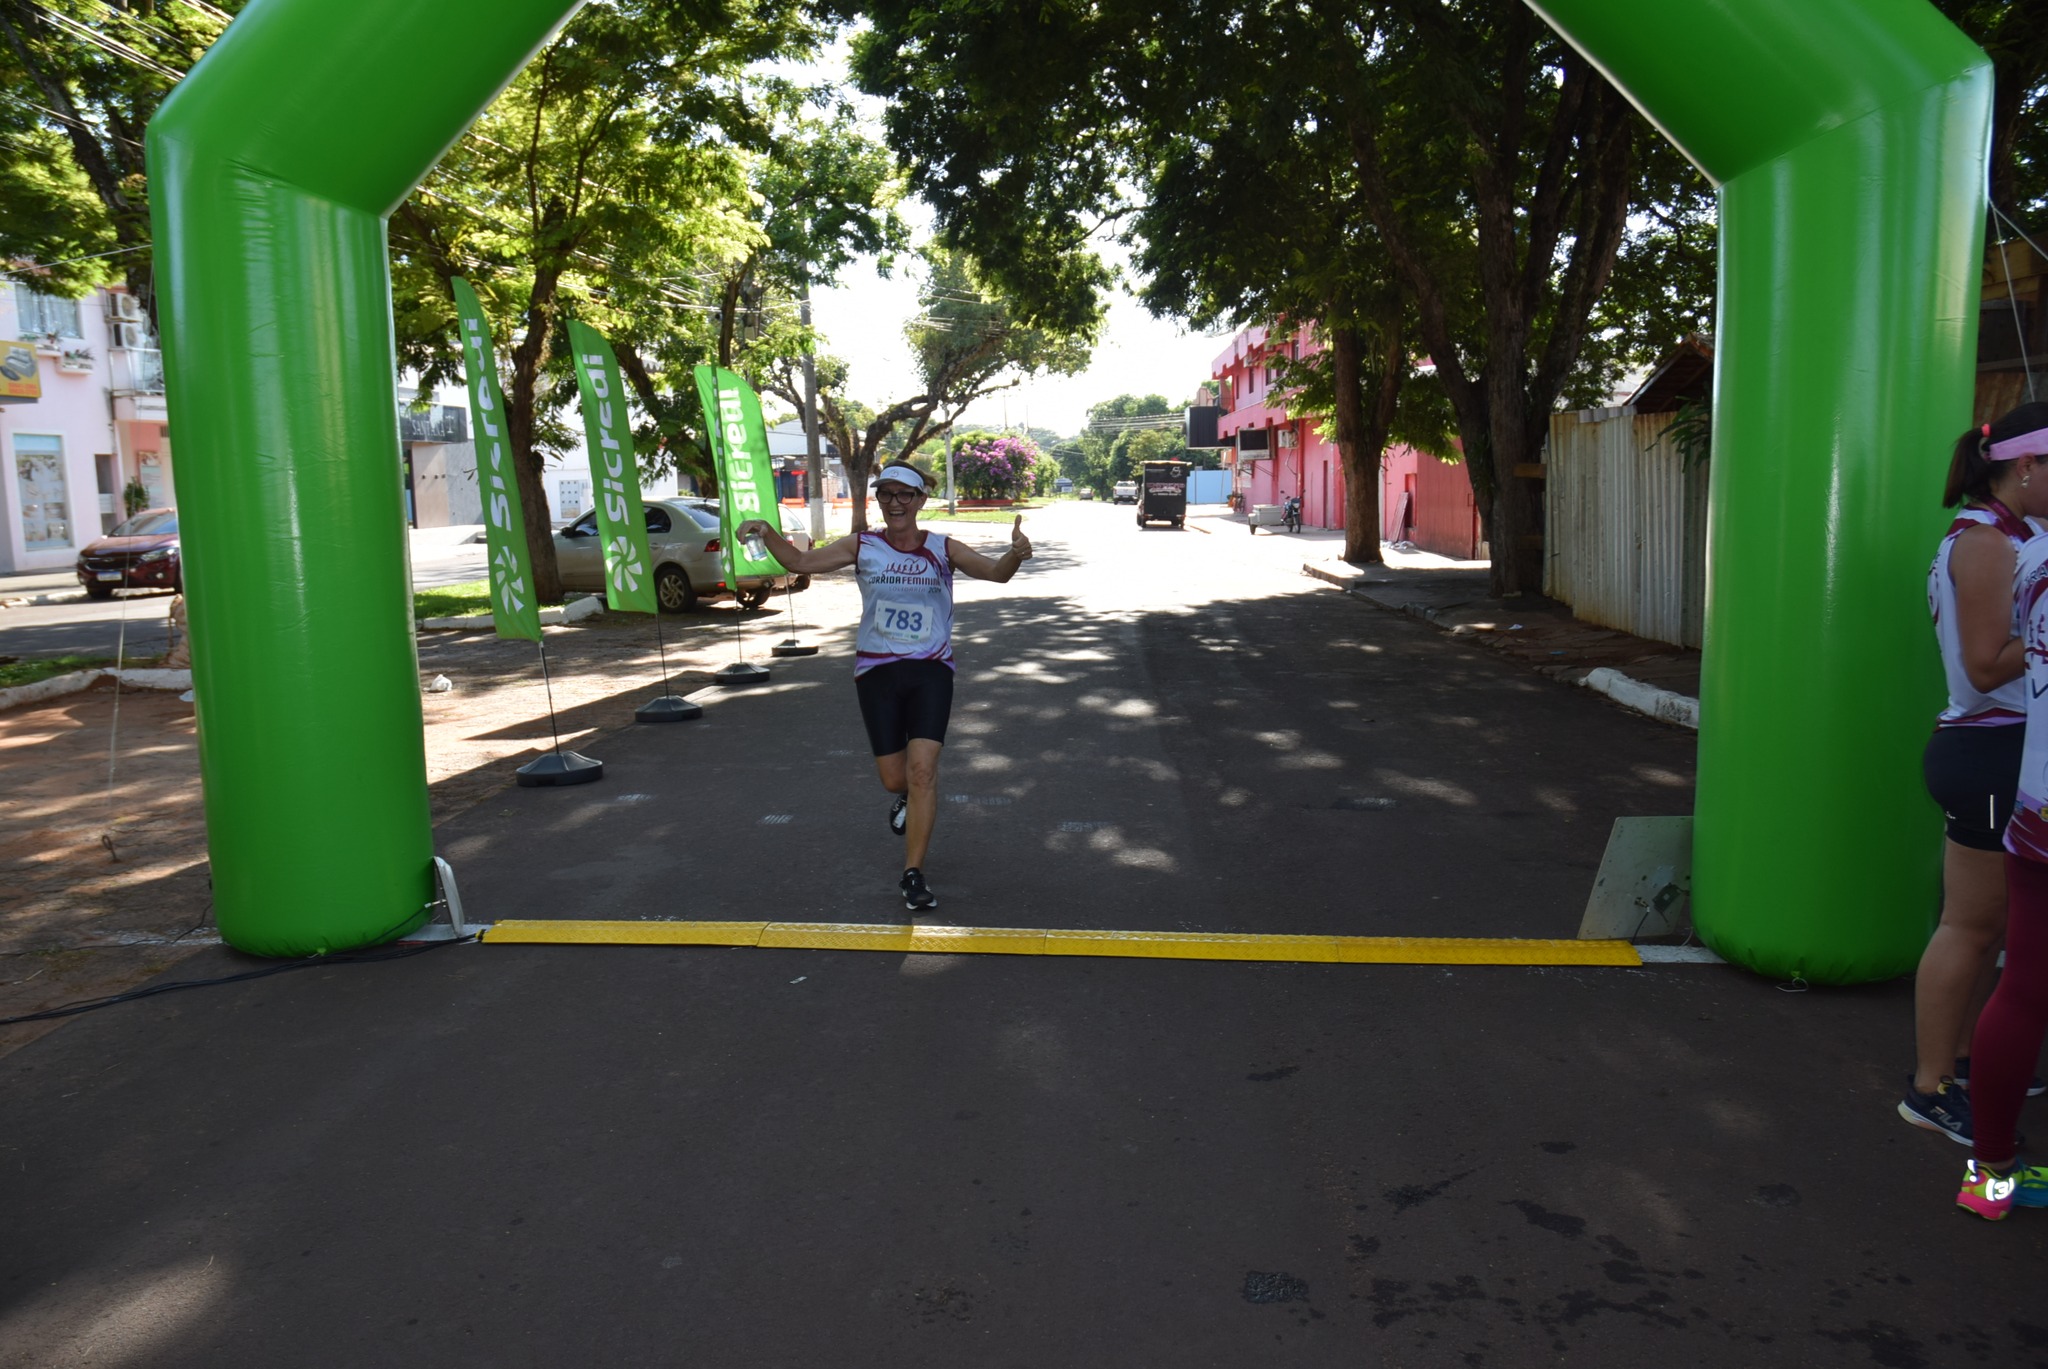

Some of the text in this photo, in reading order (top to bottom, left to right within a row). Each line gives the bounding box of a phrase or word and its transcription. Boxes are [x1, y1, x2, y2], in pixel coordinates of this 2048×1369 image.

[582, 354, 629, 526] Sicredi
[719, 387, 760, 514] Sicredi
[885, 607, 923, 632] 783
[1930, 1106, 1963, 1132] FILA
